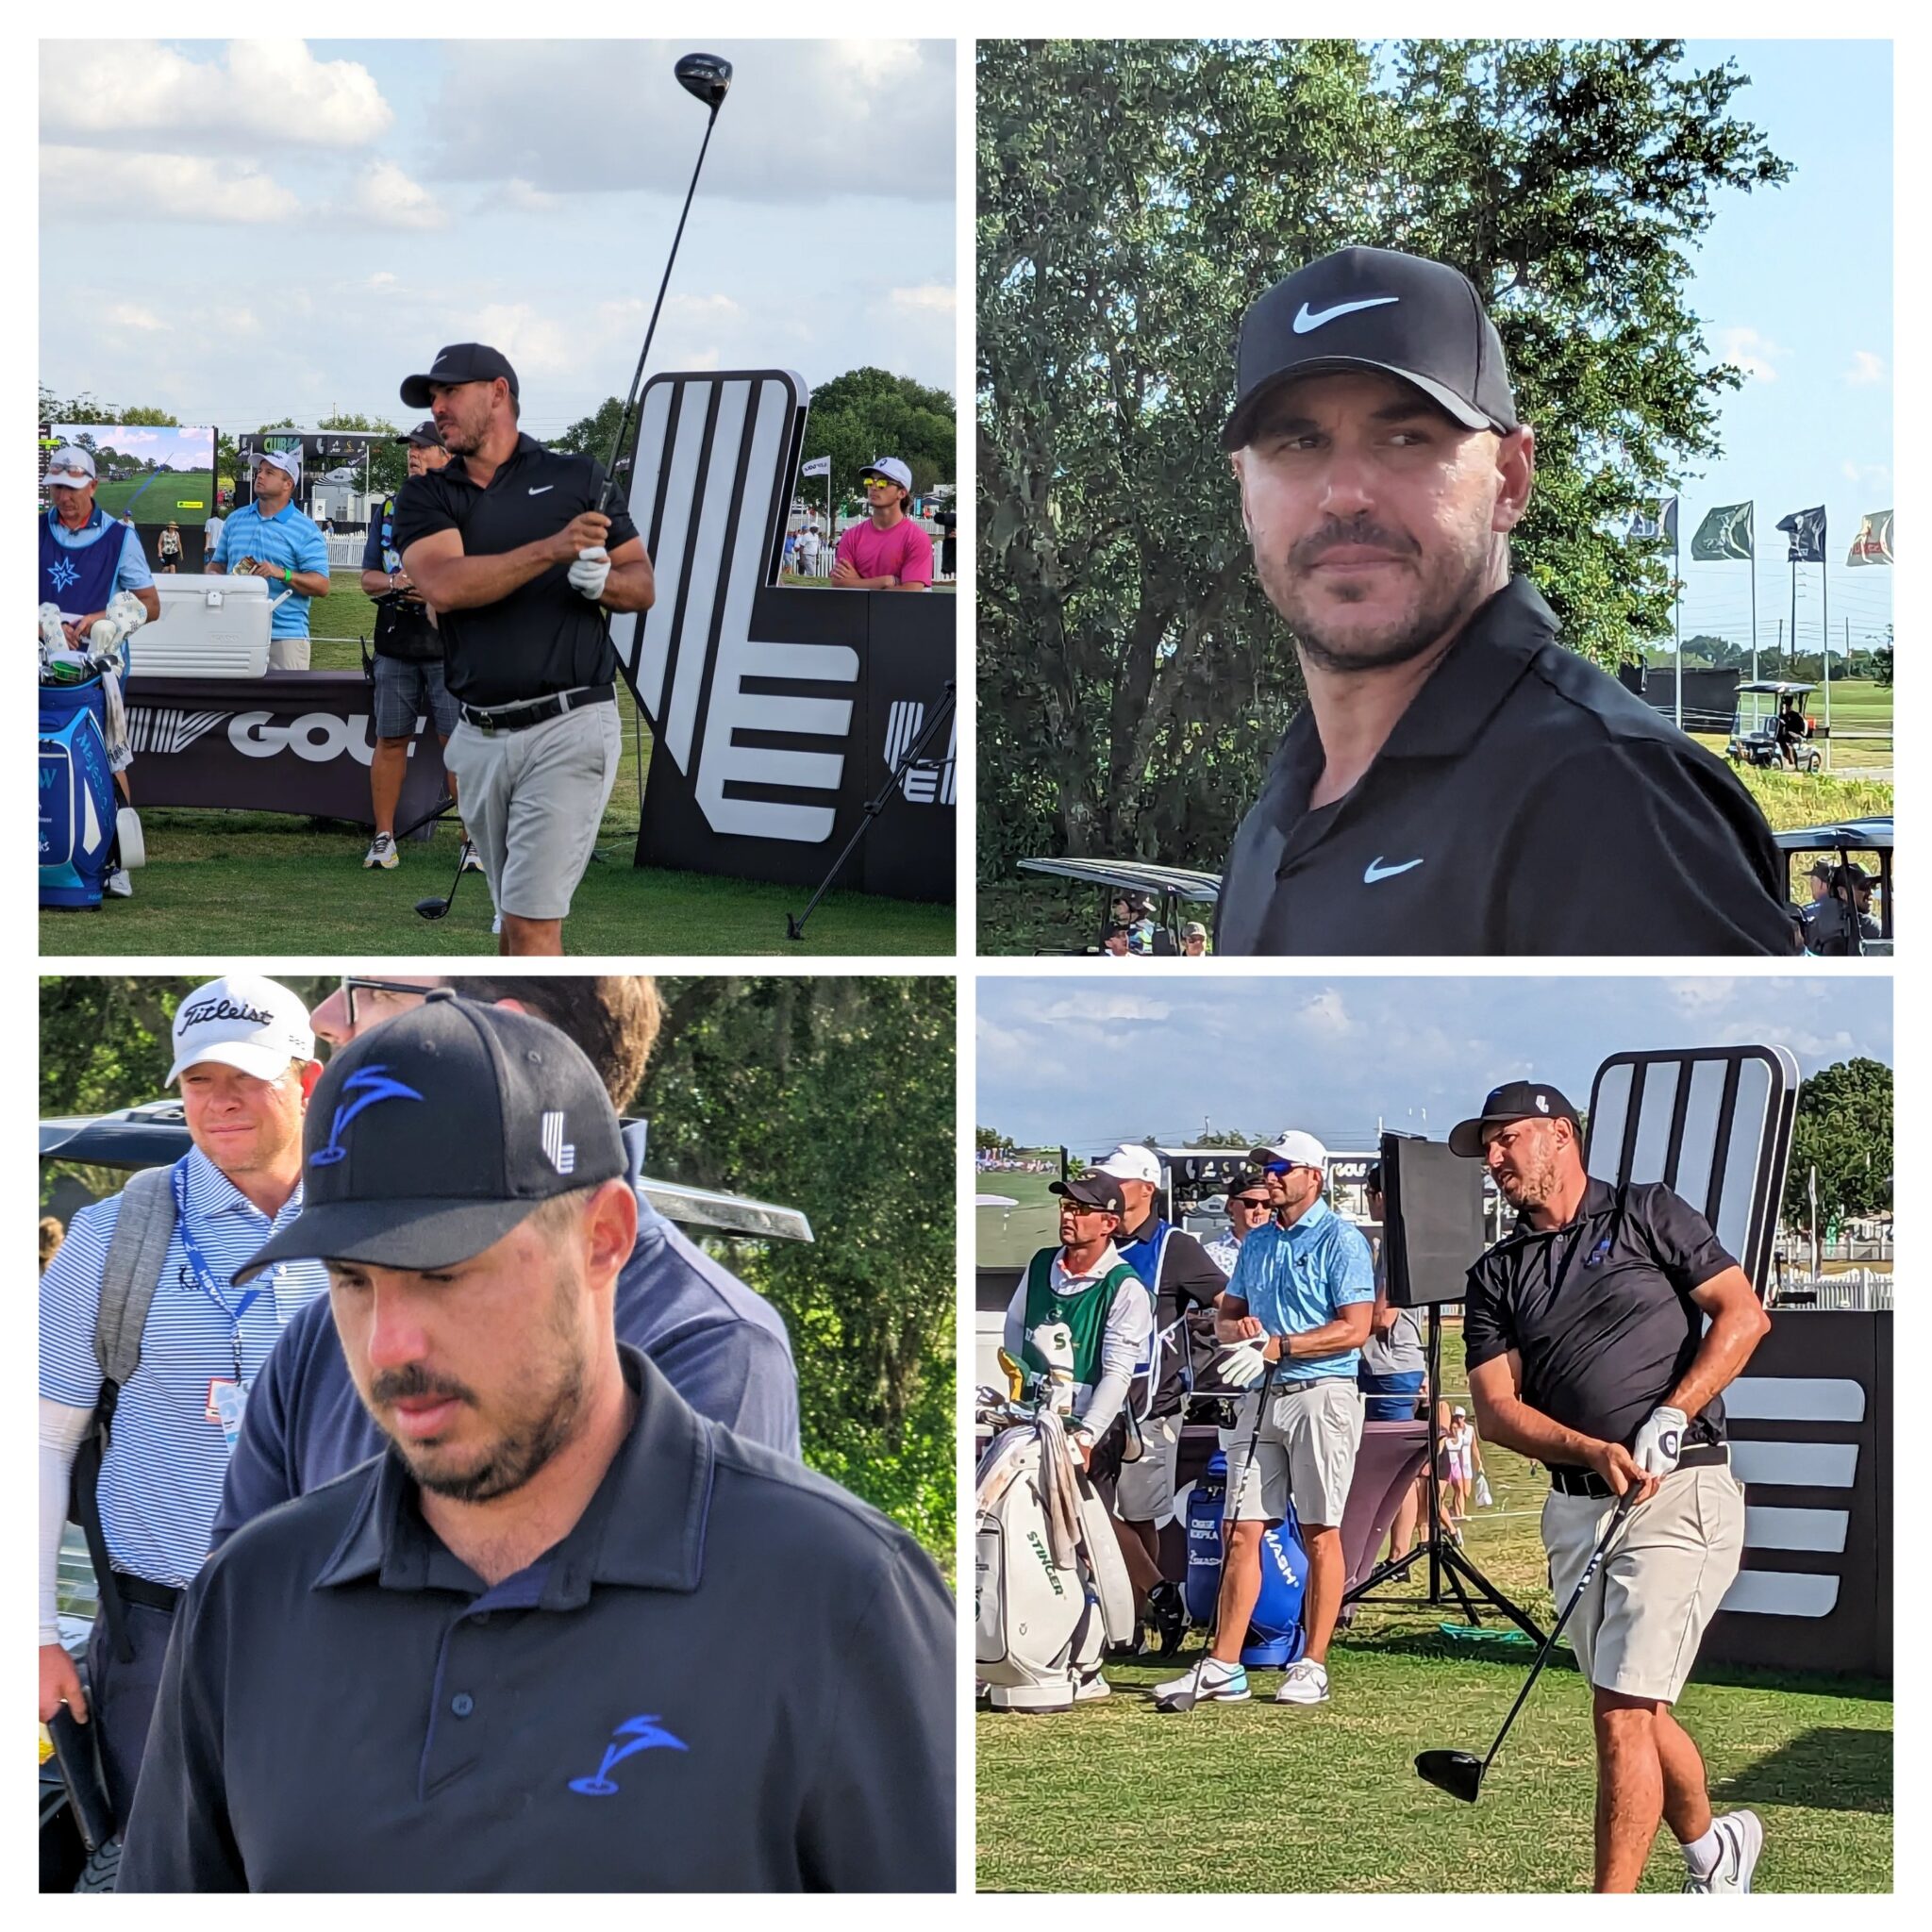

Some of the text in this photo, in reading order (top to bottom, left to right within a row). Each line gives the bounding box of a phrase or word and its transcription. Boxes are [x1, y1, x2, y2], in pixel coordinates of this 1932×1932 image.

[177, 997, 275, 1037] Titleist
[1025, 1530, 1064, 1596] STINGER
[1263, 1529, 1297, 1586] MASH
